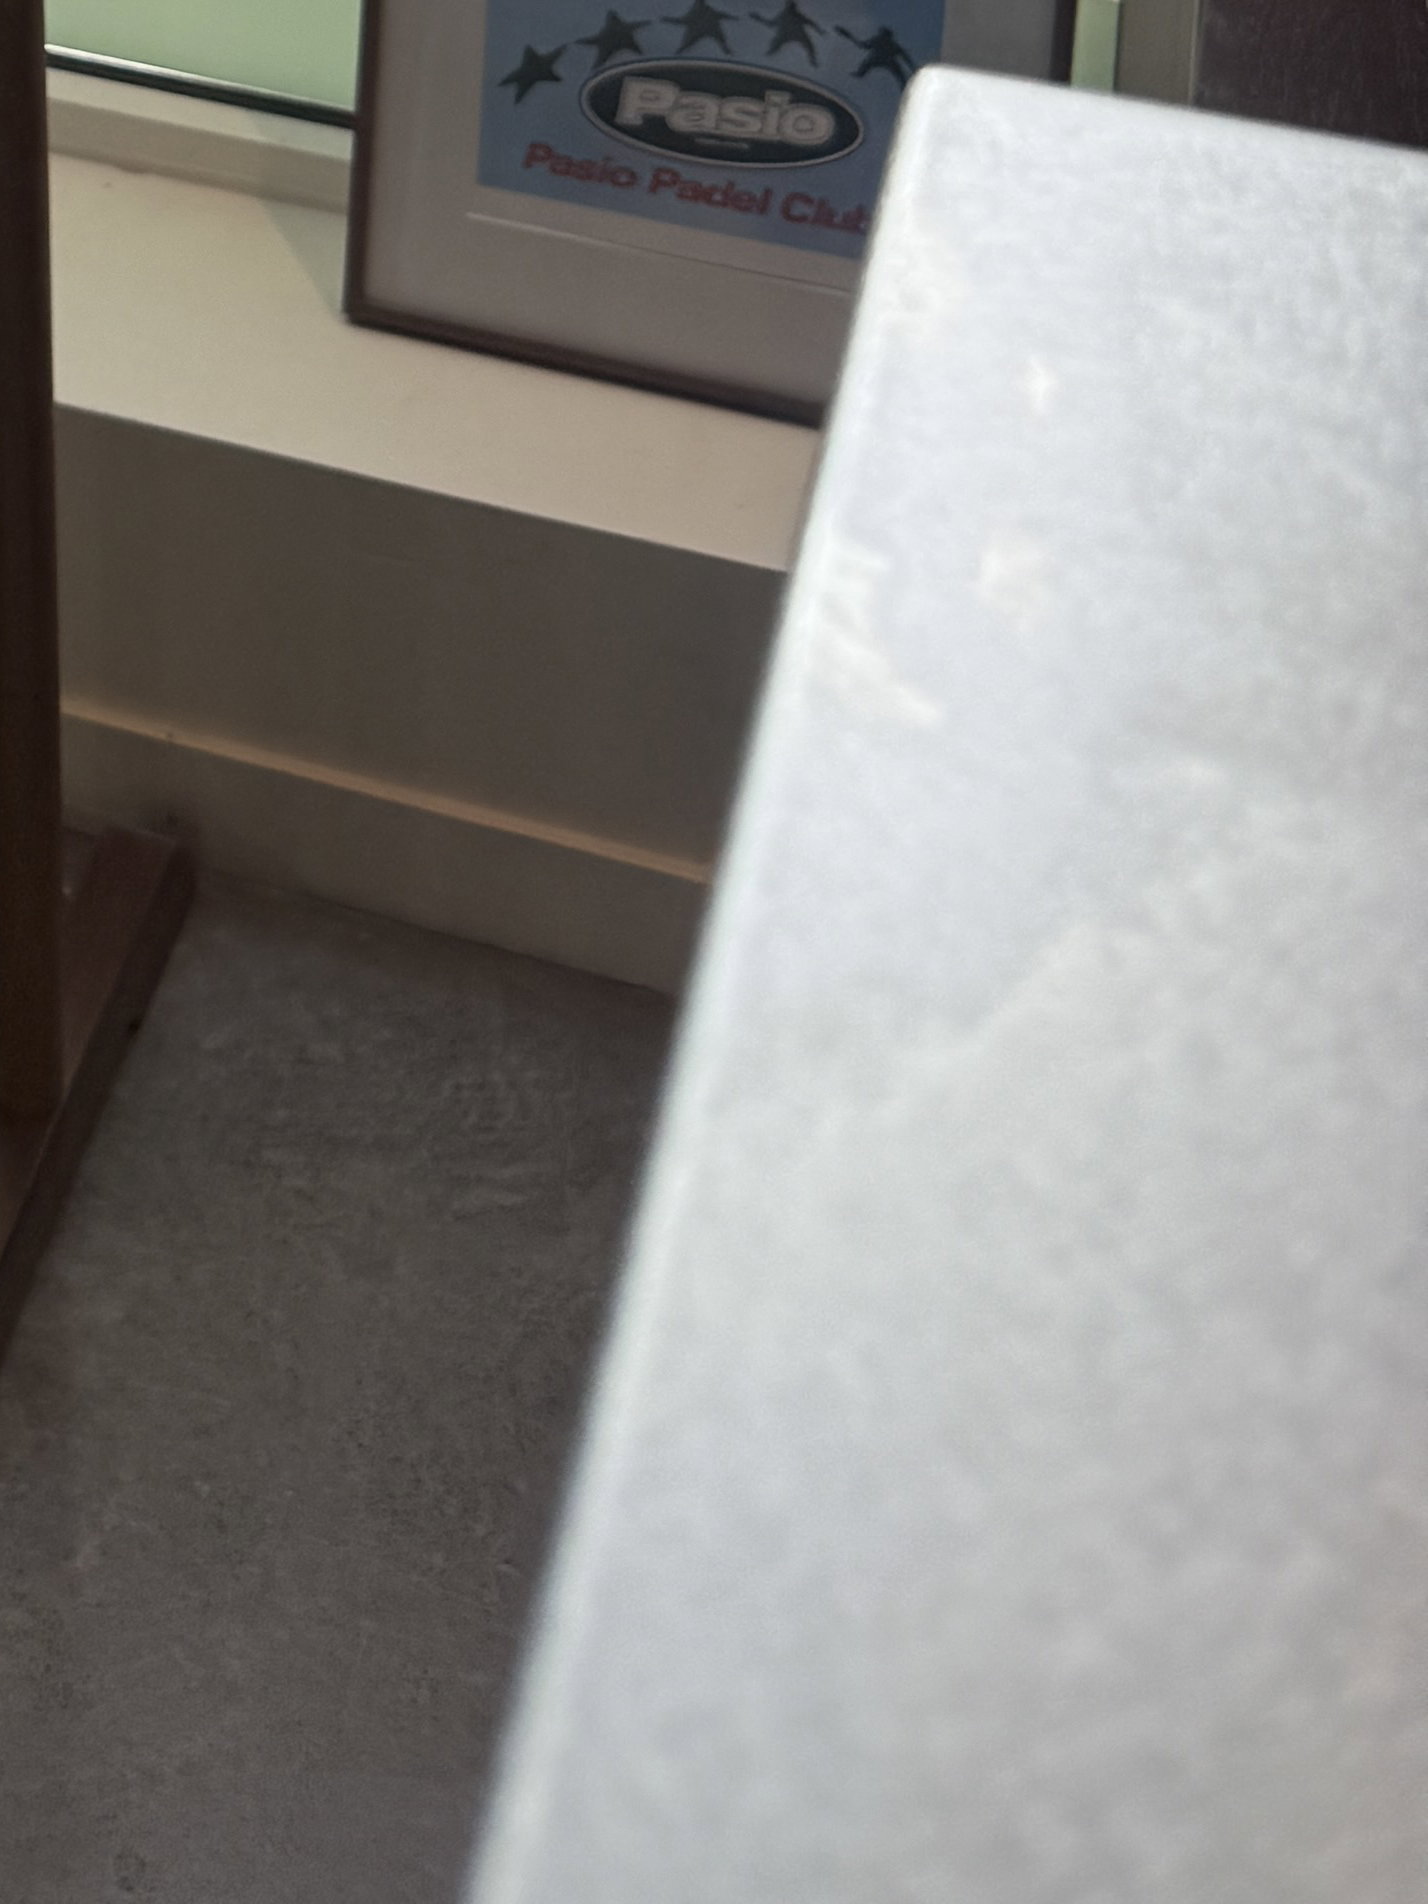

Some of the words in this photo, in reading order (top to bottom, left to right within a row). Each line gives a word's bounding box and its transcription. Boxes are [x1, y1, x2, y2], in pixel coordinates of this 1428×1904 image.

[613, 75, 838, 145] Pasio
[522, 142, 639, 188] Pasio
[648, 166, 774, 216] Padel
